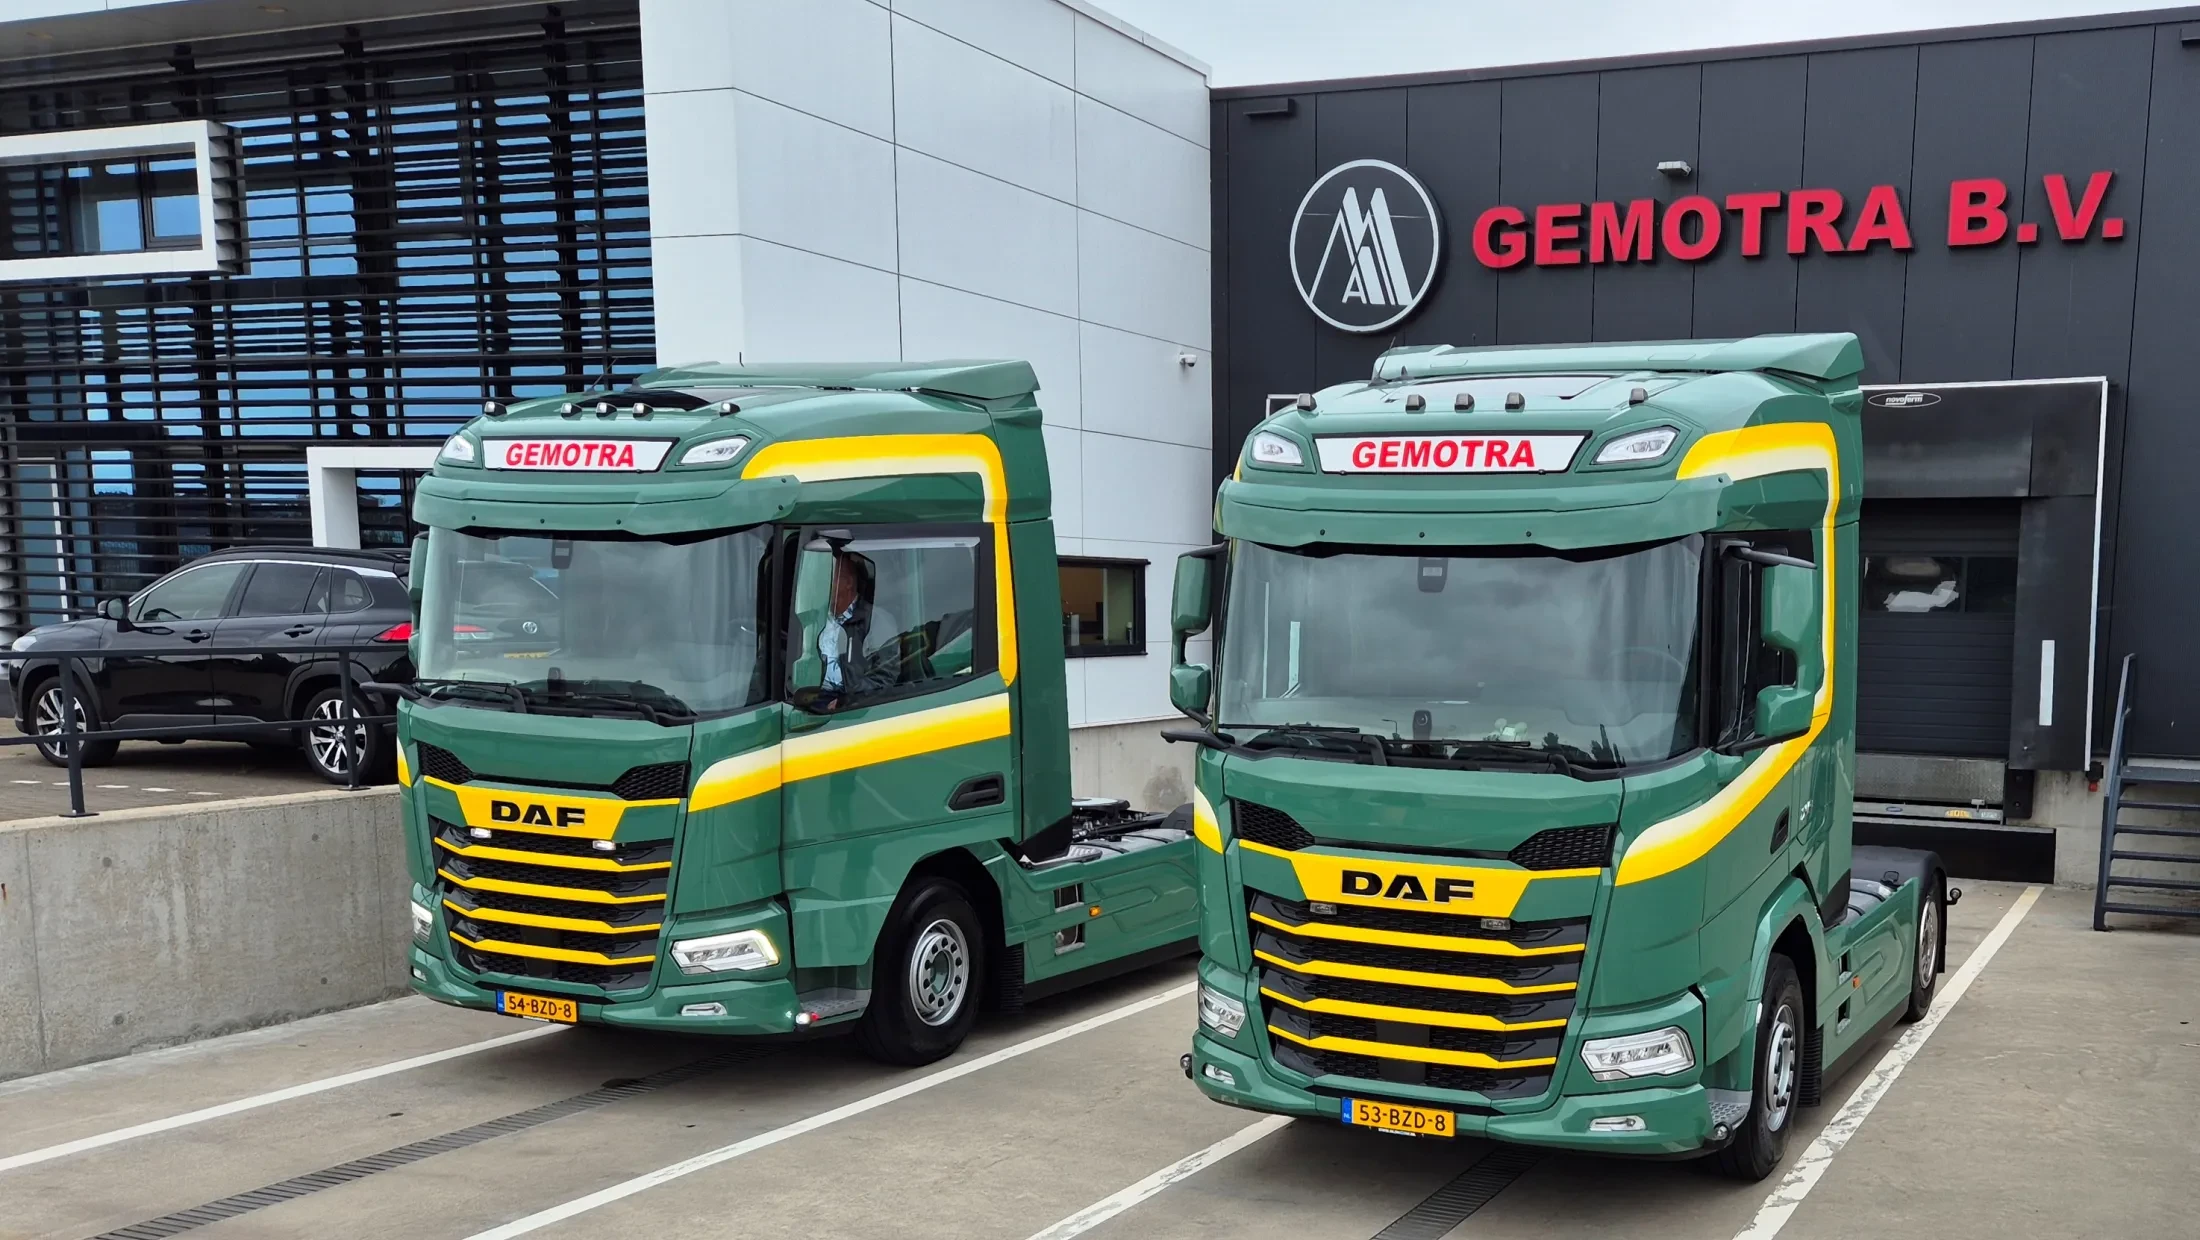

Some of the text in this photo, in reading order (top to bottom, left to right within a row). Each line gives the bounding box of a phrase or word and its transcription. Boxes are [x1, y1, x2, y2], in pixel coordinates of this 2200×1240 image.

[1473, 172, 2123, 268] GEMOTRA B.V.
[1885, 394, 1924, 406] novoferm
[505, 443, 634, 467] GEMOTRA
[1352, 440, 1535, 468] GEMOTRA
[491, 799, 585, 827] DAF
[1341, 869, 1474, 903] DAF
[508, 996, 572, 1018] 54-BZD-8
[1360, 1104, 1446, 1132] 53-BZD-8
